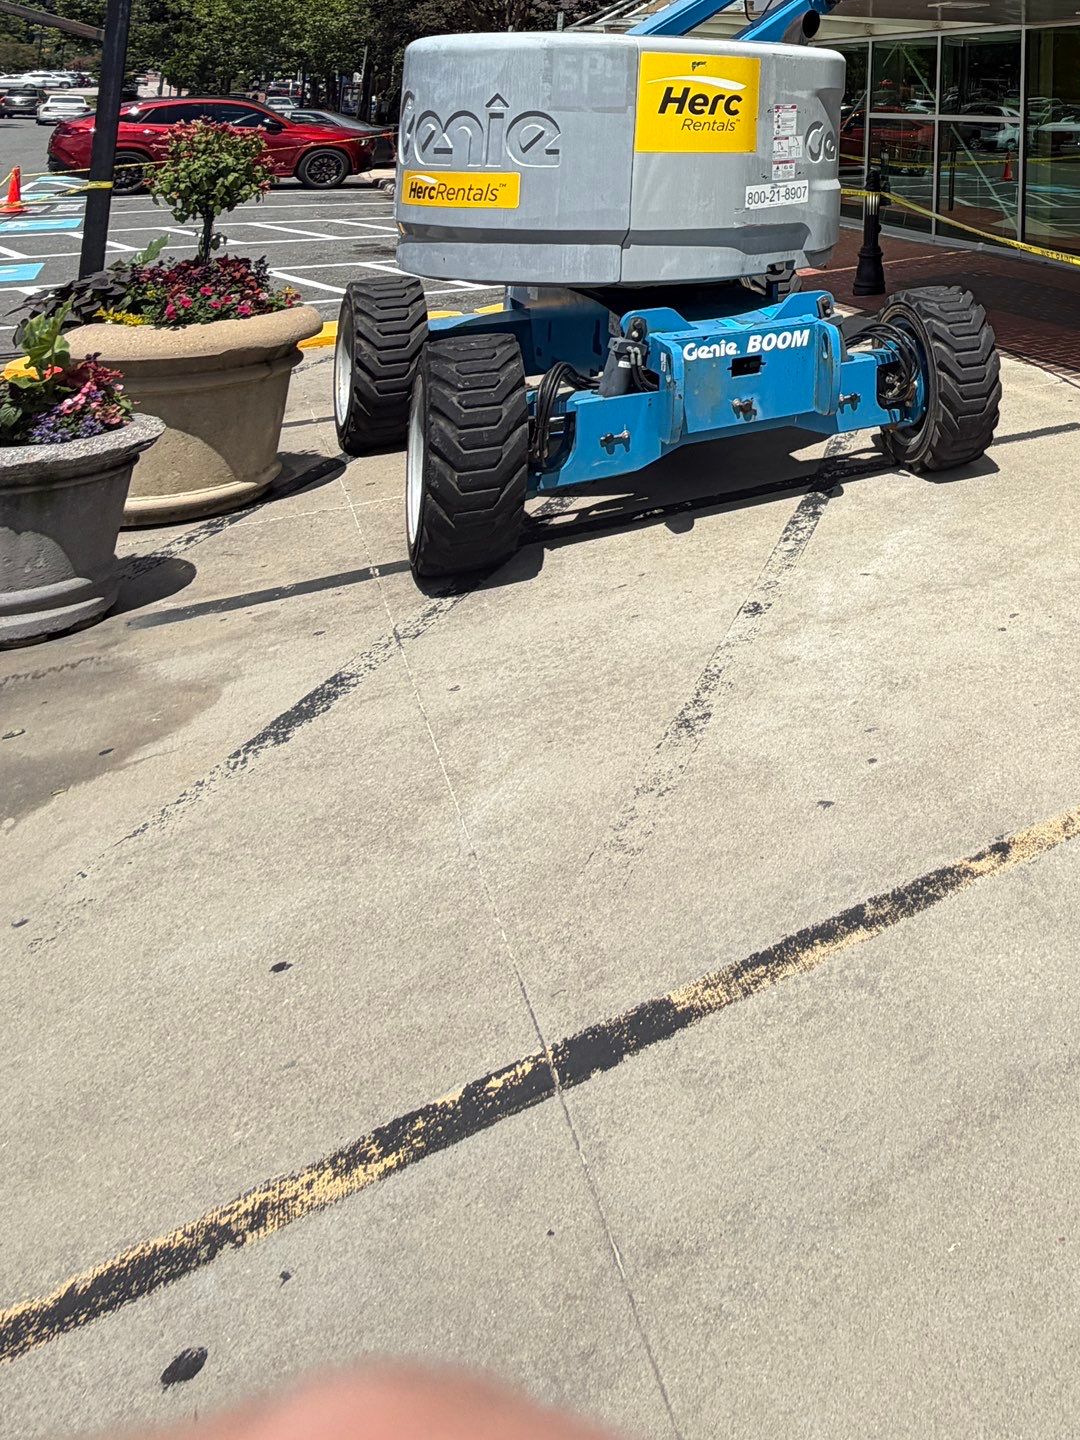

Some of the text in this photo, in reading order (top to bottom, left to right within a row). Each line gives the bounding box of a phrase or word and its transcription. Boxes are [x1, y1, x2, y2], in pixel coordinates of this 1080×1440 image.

[657, 86, 743, 116] Herc
[747, 185, 808, 206] 800-21-8907
[747, 329, 811, 354] BOOM
